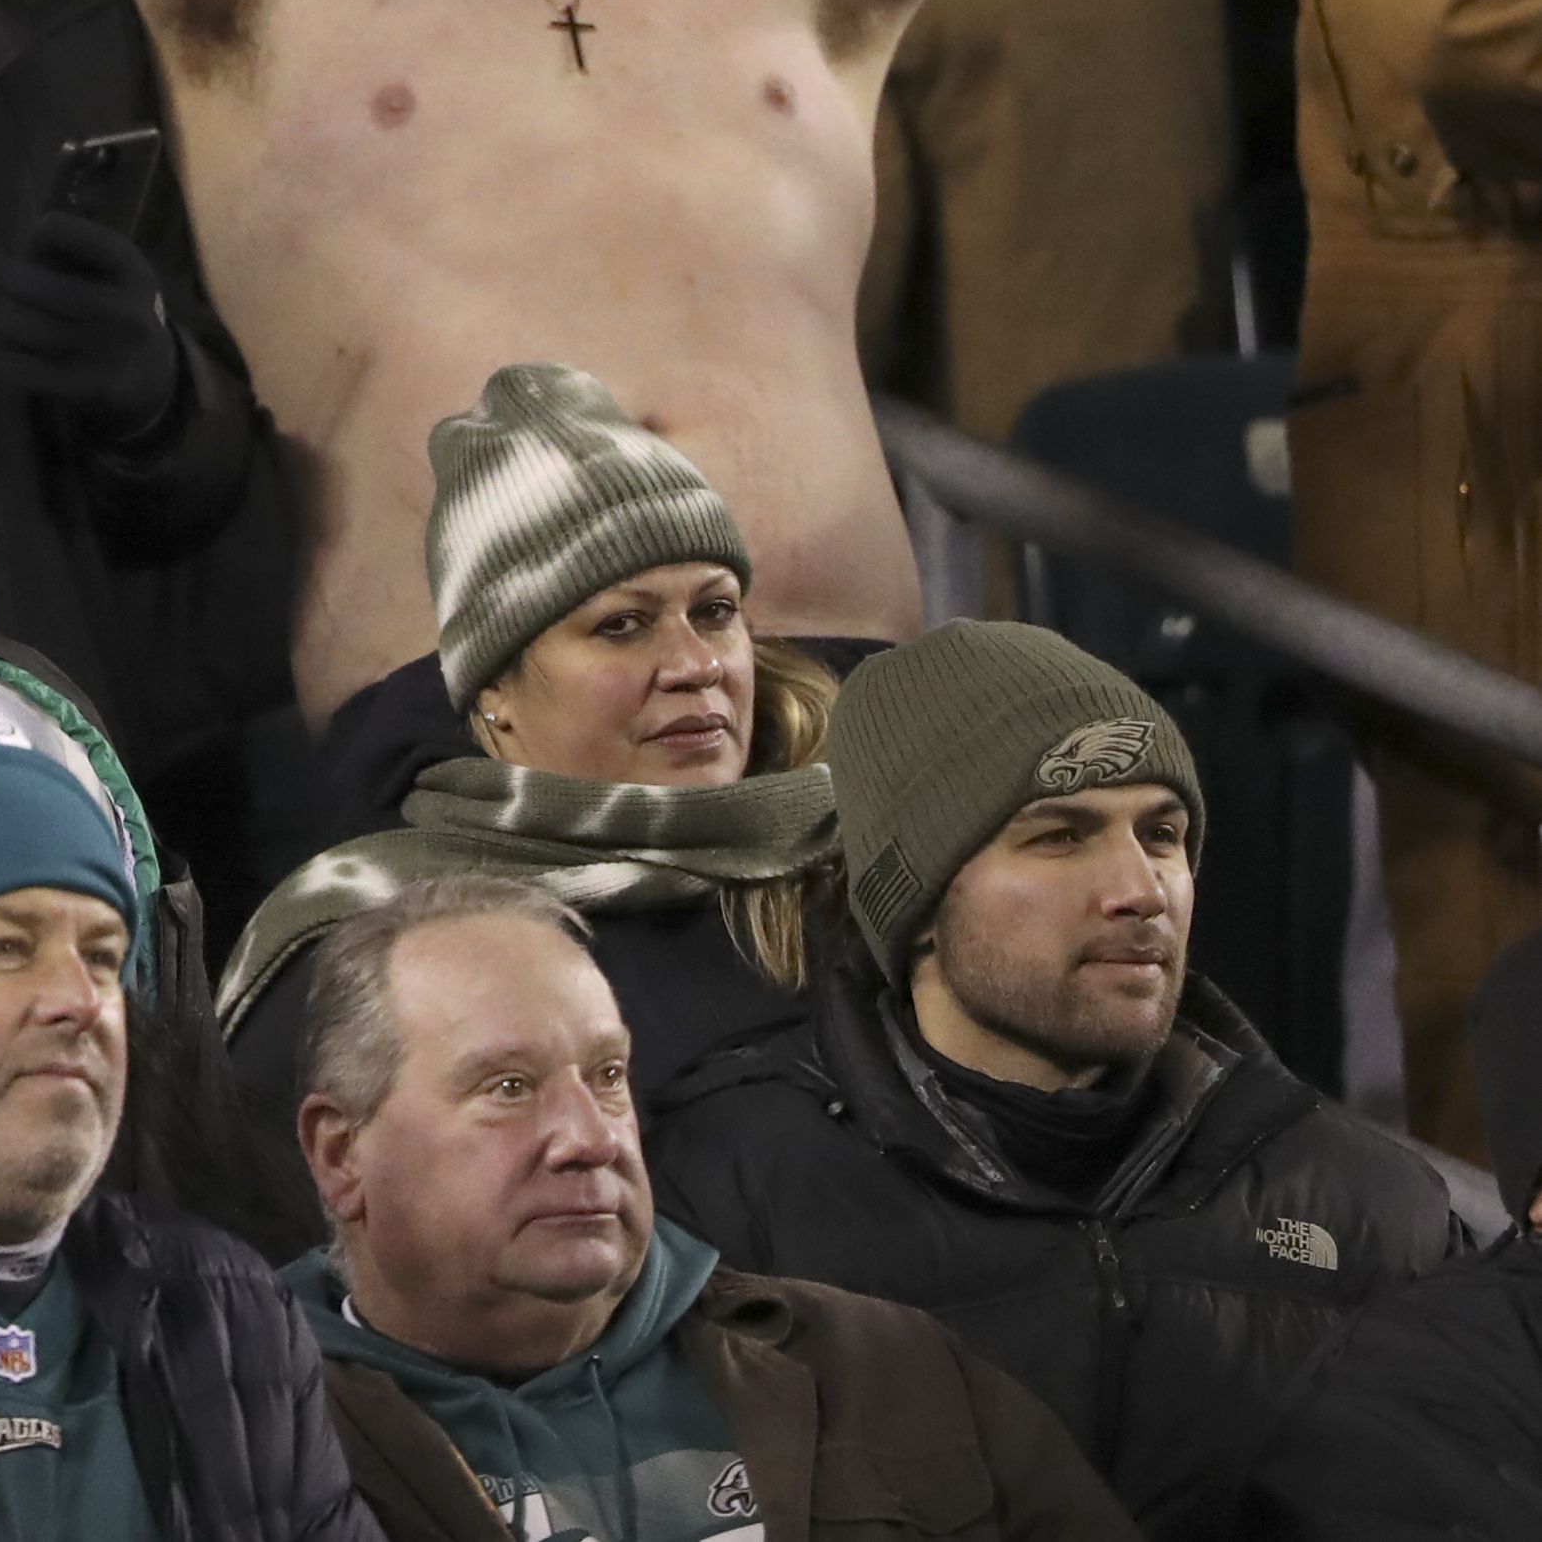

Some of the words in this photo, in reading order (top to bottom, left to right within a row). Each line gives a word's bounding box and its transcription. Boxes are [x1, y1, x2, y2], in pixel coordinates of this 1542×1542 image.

[1277, 1218, 1310, 1236] THE
[1255, 1227, 1311, 1250] NORTH
[1269, 1244, 1311, 1265] FACE
